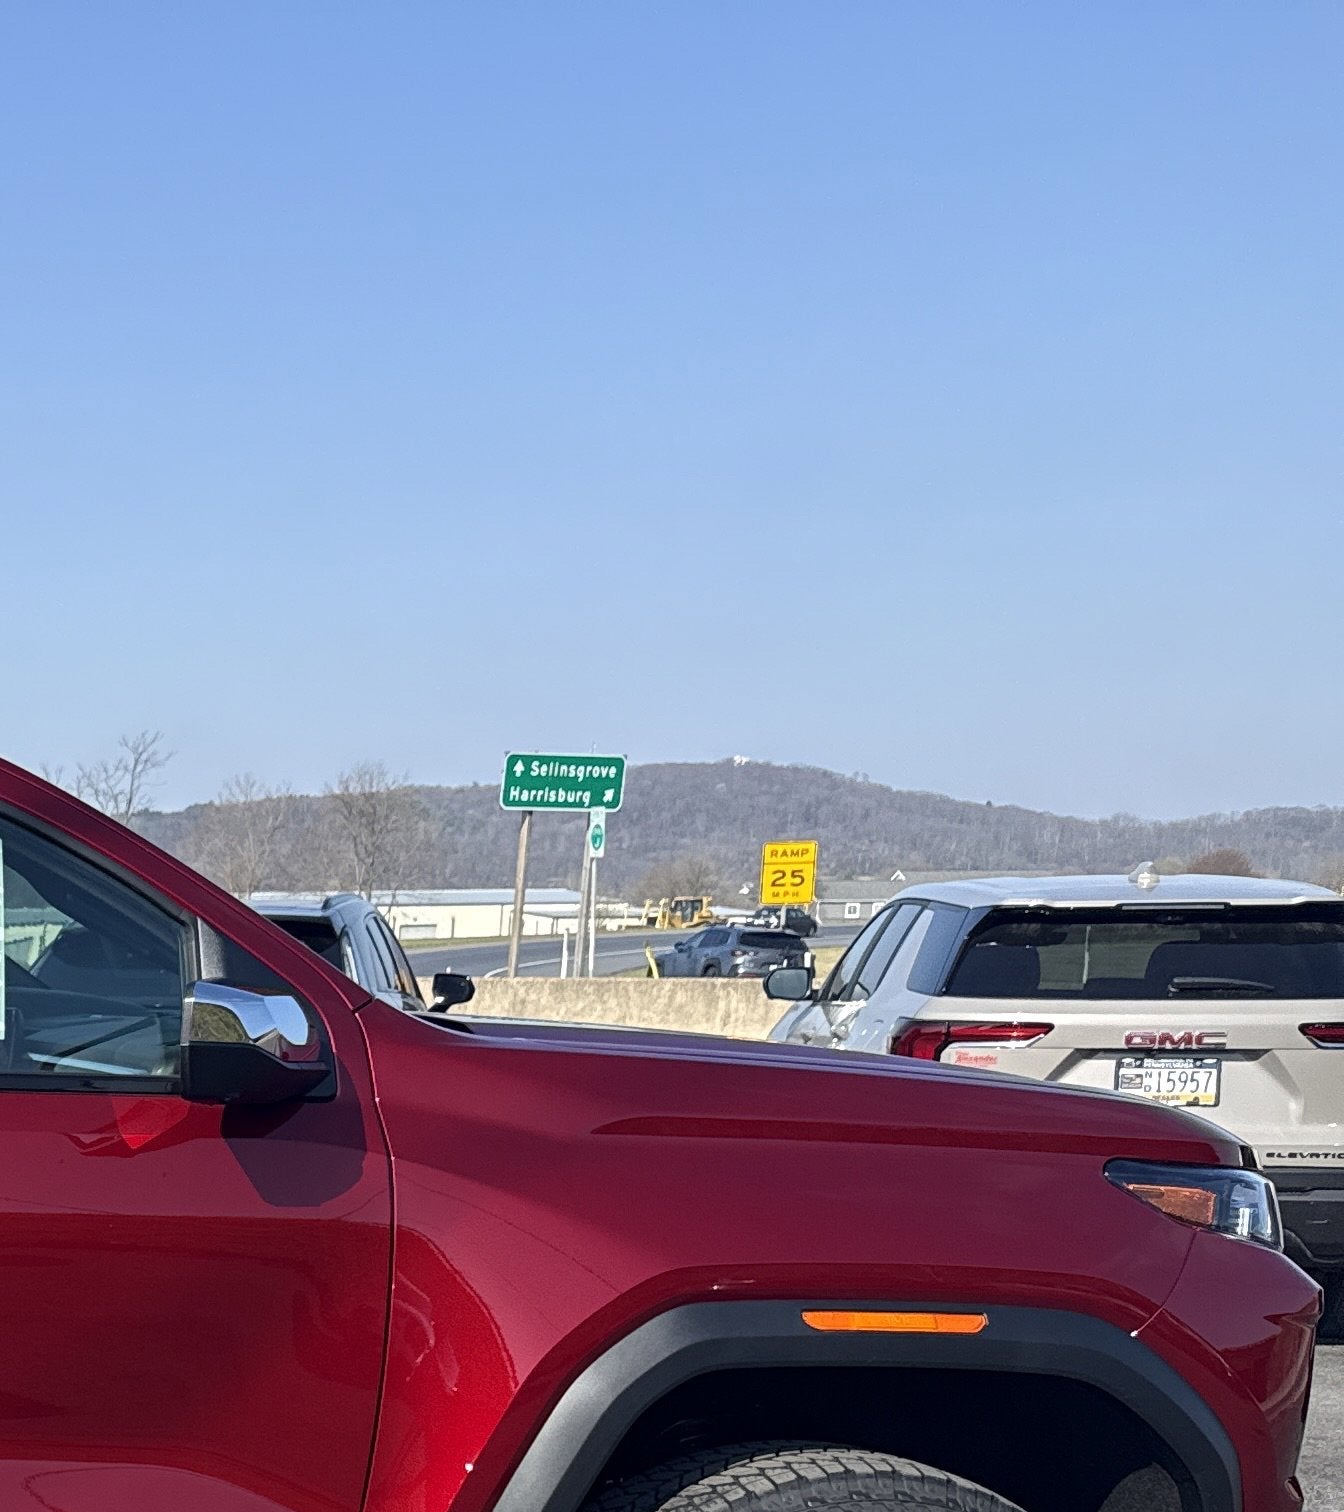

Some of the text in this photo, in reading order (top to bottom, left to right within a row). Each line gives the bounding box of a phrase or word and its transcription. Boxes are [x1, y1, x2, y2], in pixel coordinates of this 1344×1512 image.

[530, 760, 617, 782] Selinsgrove
[509, 786, 591, 807] Harrisburg
[770, 848, 810, 859] RAMP
[770, 869, 805, 887] 25
[1124, 1031, 1228, 1049] GMC
[1156, 1070, 1213, 1093] 15957
